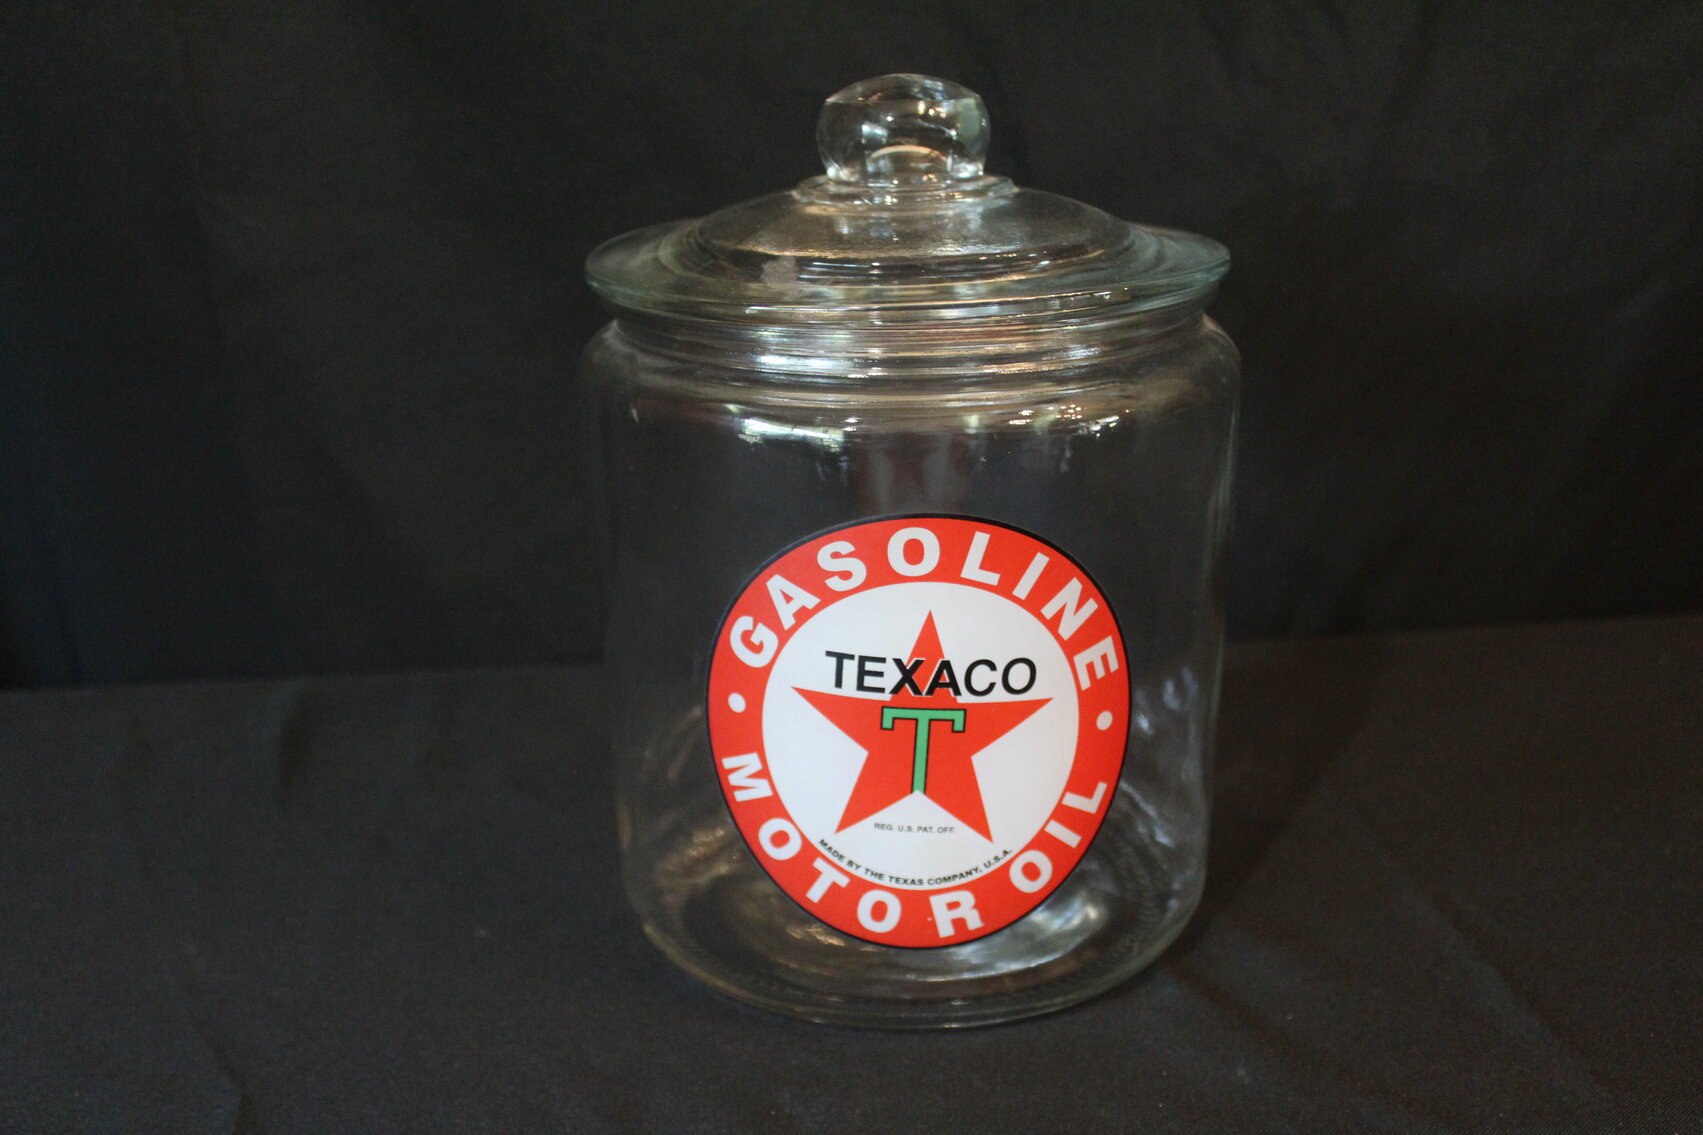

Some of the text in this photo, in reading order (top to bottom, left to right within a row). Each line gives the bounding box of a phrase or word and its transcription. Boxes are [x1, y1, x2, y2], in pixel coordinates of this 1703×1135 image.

[729, 527, 1120, 691] GASOLINE
[825, 650, 1037, 697] TEXACO
[880, 706, 967, 795] T
[721, 753, 1107, 938] MOTOR OIL
[874, 823, 895, 831] REG.
[897, 825, 914, 833] U.S.
[917, 826, 935, 834] PAT.
[818, 839, 1013, 887] MADE BY THE TEXAS COMPANY, U.S.A.
